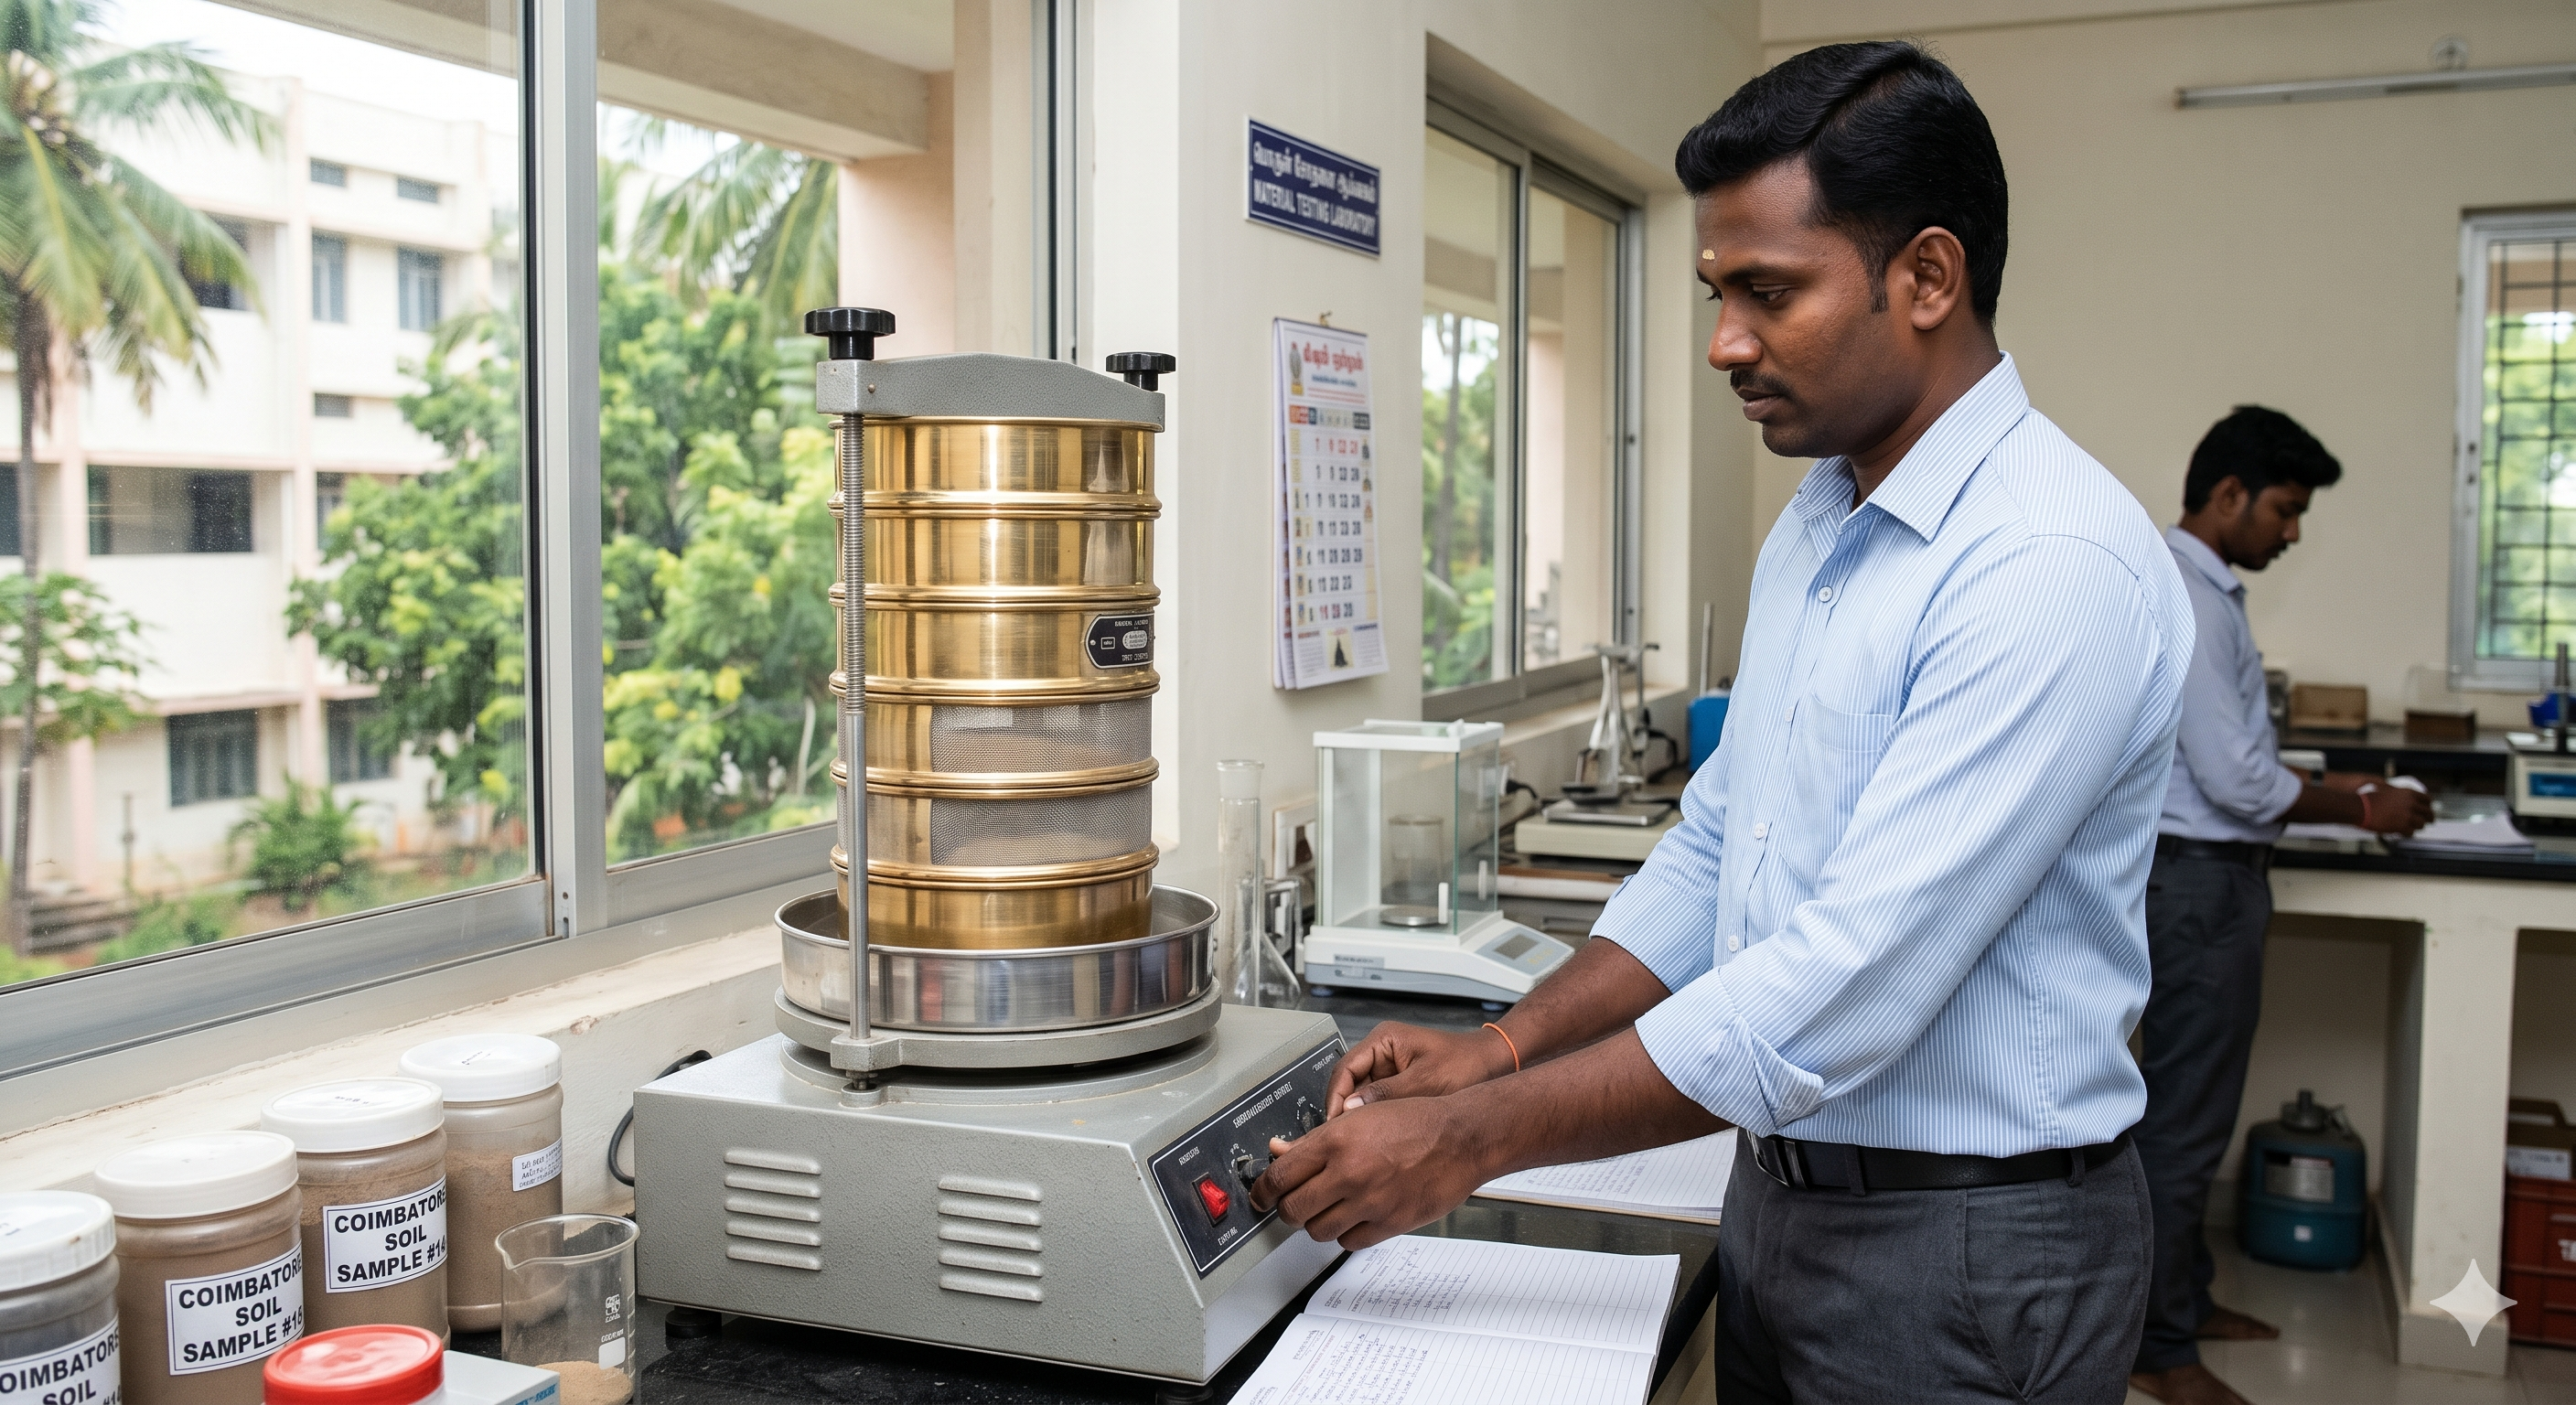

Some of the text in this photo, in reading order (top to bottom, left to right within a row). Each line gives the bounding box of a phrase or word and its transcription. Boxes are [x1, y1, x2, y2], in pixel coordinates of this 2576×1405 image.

[1296, 192, 1329, 224] TESTING
[334, 1185, 446, 1233] COIMBATORE
[385, 1225, 427, 1251] SOIL
[178, 1252, 302, 1309] COIMBATORE
[338, 1249, 423, 1282] SAMPLE
[236, 1296, 282, 1326] SOIL
[183, 1323, 276, 1363] SAMPLE
[0, 1326, 119, 1394] OIMBATORE
[43, 1379, 96, 1405] SOIL
